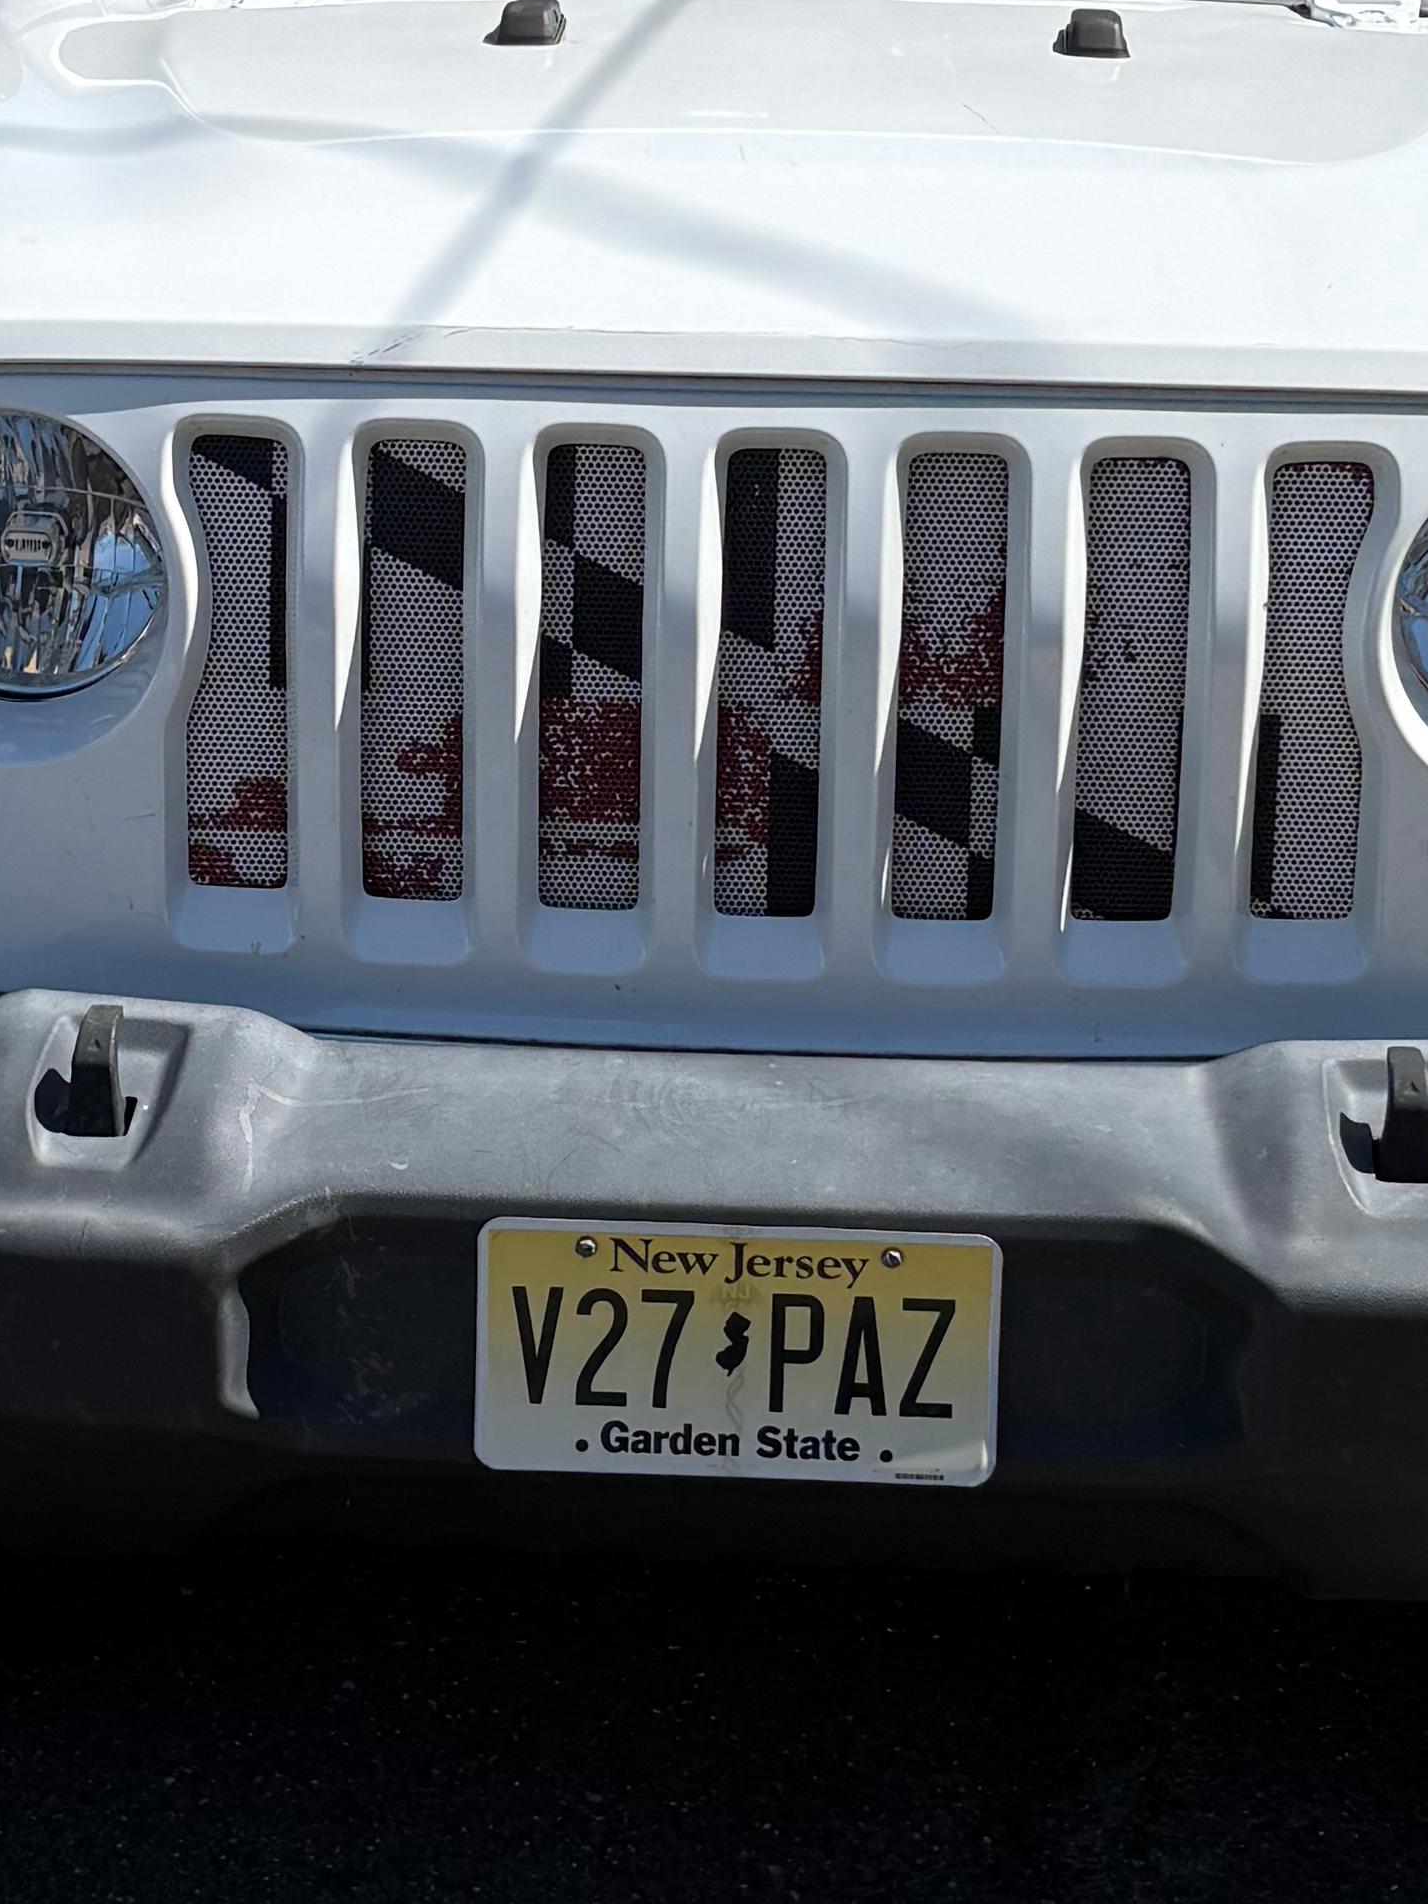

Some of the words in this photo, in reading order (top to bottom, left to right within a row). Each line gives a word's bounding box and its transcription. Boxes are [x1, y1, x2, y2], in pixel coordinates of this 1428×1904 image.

[609, 1237, 719, 1276] New
[723, 1241, 870, 1292] Jersey
[512, 1285, 695, 1409] V27
[768, 1293, 956, 1419] PAZ
[600, 1419, 740, 1457] Garden
[755, 1425, 861, 1462] State
